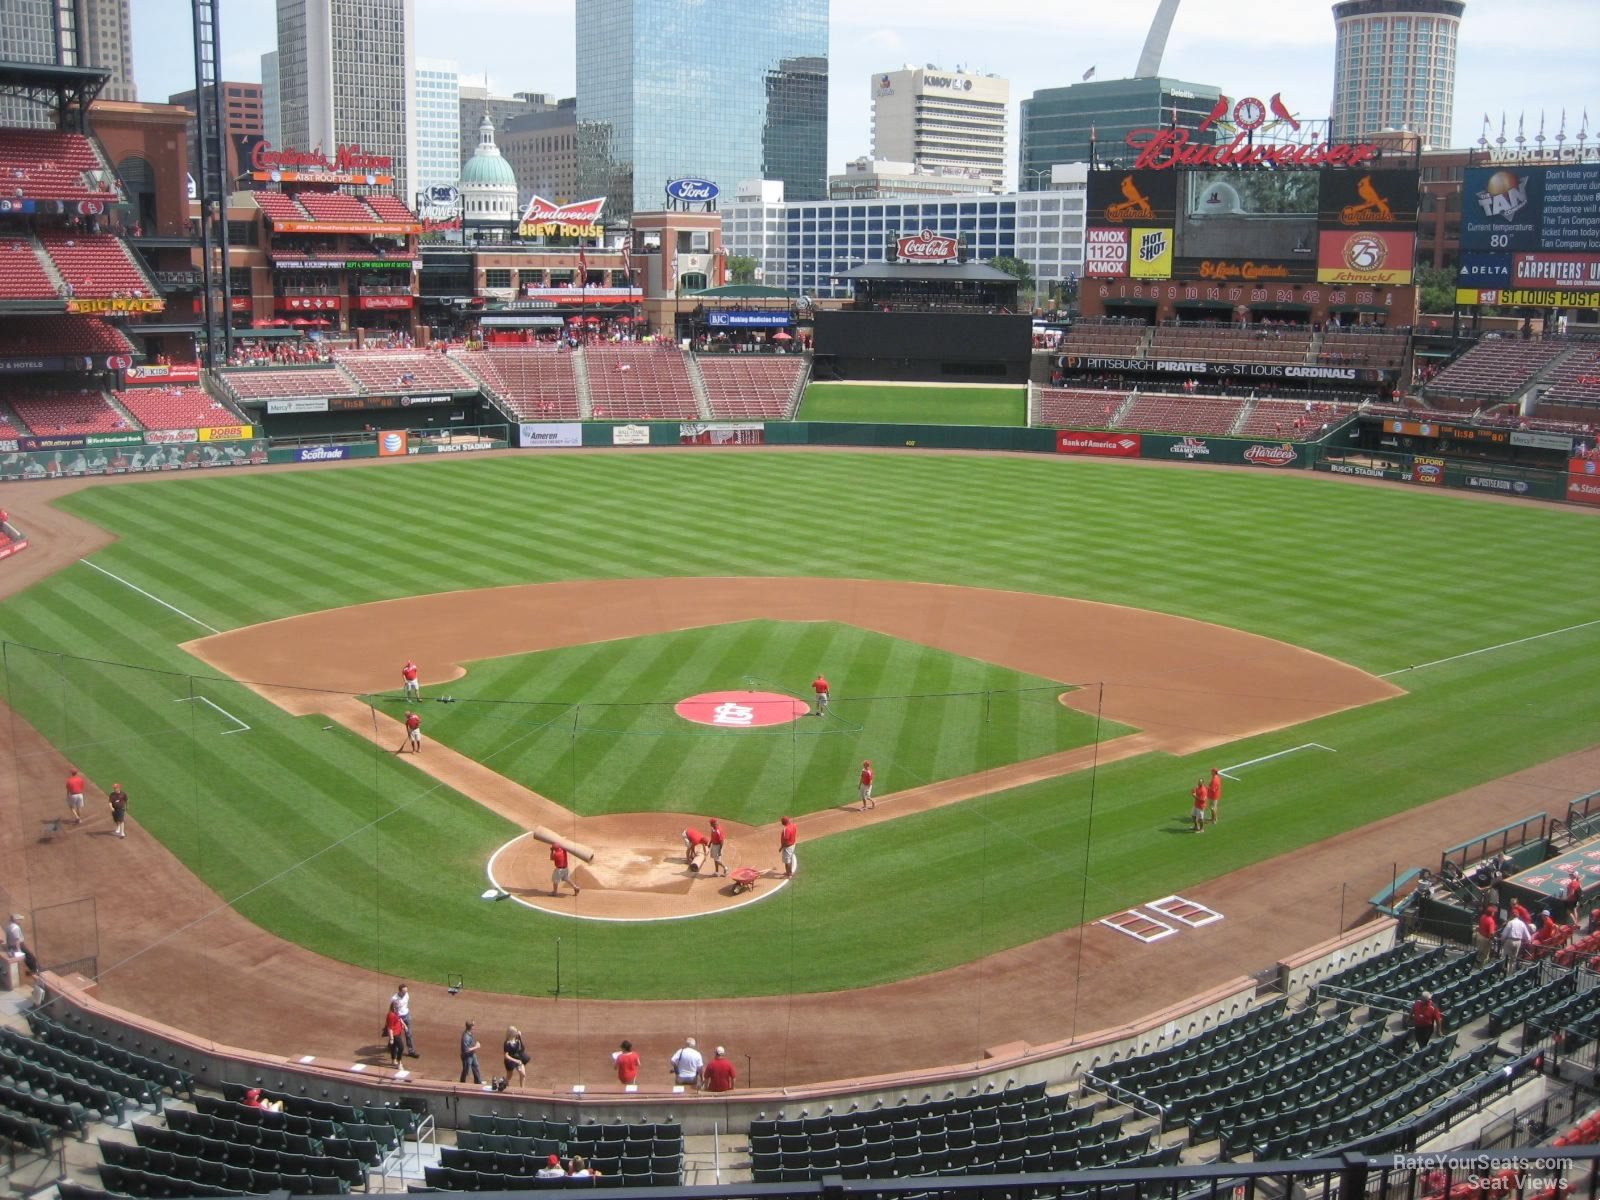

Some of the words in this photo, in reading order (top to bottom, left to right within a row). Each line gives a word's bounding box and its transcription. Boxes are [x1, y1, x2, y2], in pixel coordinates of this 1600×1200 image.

[924, 76, 952, 88] KMOV
[1126, 128, 1379, 170] Budweiser
[1489, 149, 1554, 161] WORLD
[1560, 147, 1600, 159] CHA
[252, 140, 327, 170] Cardinals
[327, 143, 392, 172] Nation
[296, 172, 314, 181] AT&T
[315, 173, 353, 183] ROOFTOP
[1546, 170, 1564, 179] Don't
[1567, 171, 1581, 179] lose
[1583, 171, 1598, 180] your
[678, 181, 710, 198] Ford
[1545, 182, 1588, 192] temperature
[1478, 176, 1528, 217] TAN
[1544, 194, 1571, 202] reaches
[1573, 193, 1594, 202] above
[420, 206, 464, 217] MIDWEST
[519, 204, 602, 223] Budweiser
[1104, 204, 1157, 222] Cardinals
[1543, 205, 1581, 214] attendance
[1584, 204, 1596, 213] will
[1340, 207, 1394, 225] Cardinals
[1543, 216, 1555, 224] The
[1557, 216, 1569, 225] Tan
[519, 224, 557, 236] BREW
[560, 225, 604, 237] HOUSE
[1467, 223, 1491, 231] Current
[1542, 228, 1560, 237] ticket
[1563, 227, 1578, 236] from
[1090, 231, 1124, 243] KMOX
[1142, 232, 1162, 246] HOT
[904, 240, 948, 256] Coca-Cola
[1541, 239, 1553, 248] Tan
[1555, 239, 1587, 249] Company
[1090, 245, 1124, 259] 1120
[1140, 242, 1166, 260] SHOT
[1352, 242, 1378, 267] 75
[1089, 262, 1124, 273] KMOX
[1471, 266, 1508, 274] DELTA
[1518, 261, 1585, 279] CARPENTERS'
[1133, 286, 1142, 298] 2
[1151, 286, 1159, 298] 6
[1168, 287, 1176, 299] 9
[1186, 287, 1198, 299] 10
[1207, 288, 1219, 300] 14
[1229, 288, 1242, 300] 17
[1251, 289, 1267, 302] 20
[1276, 290, 1292, 302] 24
[1303, 291, 1320, 303] 42
[1329, 291, 1346, 304] 45
[1356, 292, 1373, 304] 85
[1501, 290, 1517, 303] ST.
[1520, 291, 1556, 304] LOUIS
[1561, 291, 1600, 306] POST-
[80, 300, 109, 313] BIG
[112, 299, 153, 312] MAC
[711, 315, 727, 324] BJC
[730, 316, 748, 324] Making
[14, 361, 43, 369] HOTELS
[1087, 358, 1153, 371] PITTSBURGH
[1157, 361, 1207, 373] PIRATES
[1233, 365, 1247, 375] ST.
[1251, 366, 1282, 376] LOUIS
[1285, 367, 1355, 379] CARDINALS
[270, 404, 288, 413] Mercy
[176, 431, 196, 442] Save
[210, 428, 242, 436] DOBBS
[530, 432, 558, 440] Ameren
[1454, 430, 1474, 439] 11:58
[1063, 438, 1079, 446] Bank
[1080, 439, 1088, 447] of
[1088, 440, 1117, 449] America
[1513, 436, 1531, 444] Mercy
[437, 444, 460, 452] BUSCH
[1170, 447, 1210, 455] CHAMPIONS
[301, 448, 343, 460] Scottrade
[1414, 457, 1444, 467] STLFORD
[1331, 464, 1353, 474] BUSCH
[1354, 467, 1383, 477] STADIUM
[1420, 475, 1436, 483] .COM
[1478, 477, 1510, 489] POSTSEASON
[1581, 484, 1600, 495] State
